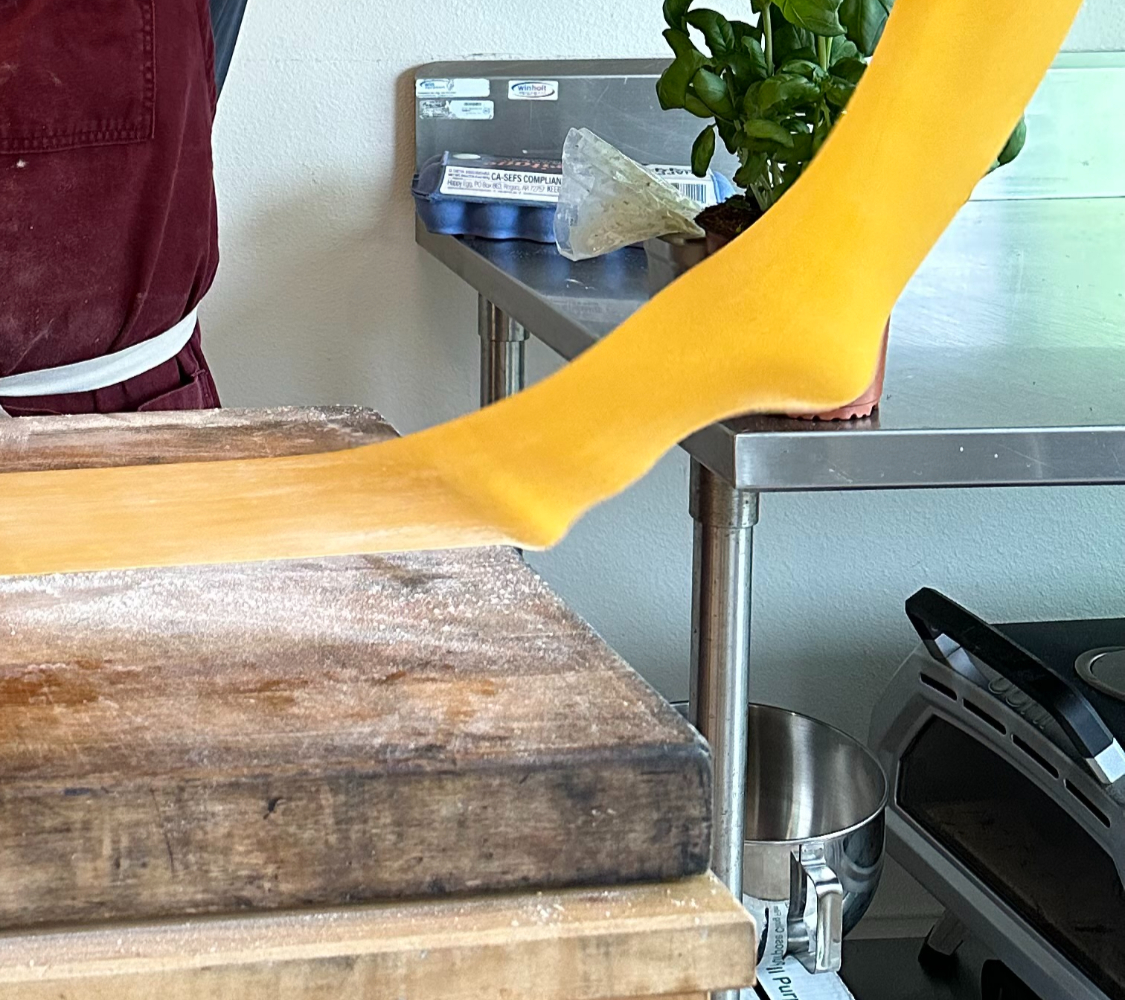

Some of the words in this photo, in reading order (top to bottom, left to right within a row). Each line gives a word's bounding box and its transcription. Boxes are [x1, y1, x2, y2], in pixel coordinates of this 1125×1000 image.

[517, 84, 547, 92] winholt
[491, 172, 522, 183] CA-SEFS
[523, 174, 562, 186] COMPLIAN
